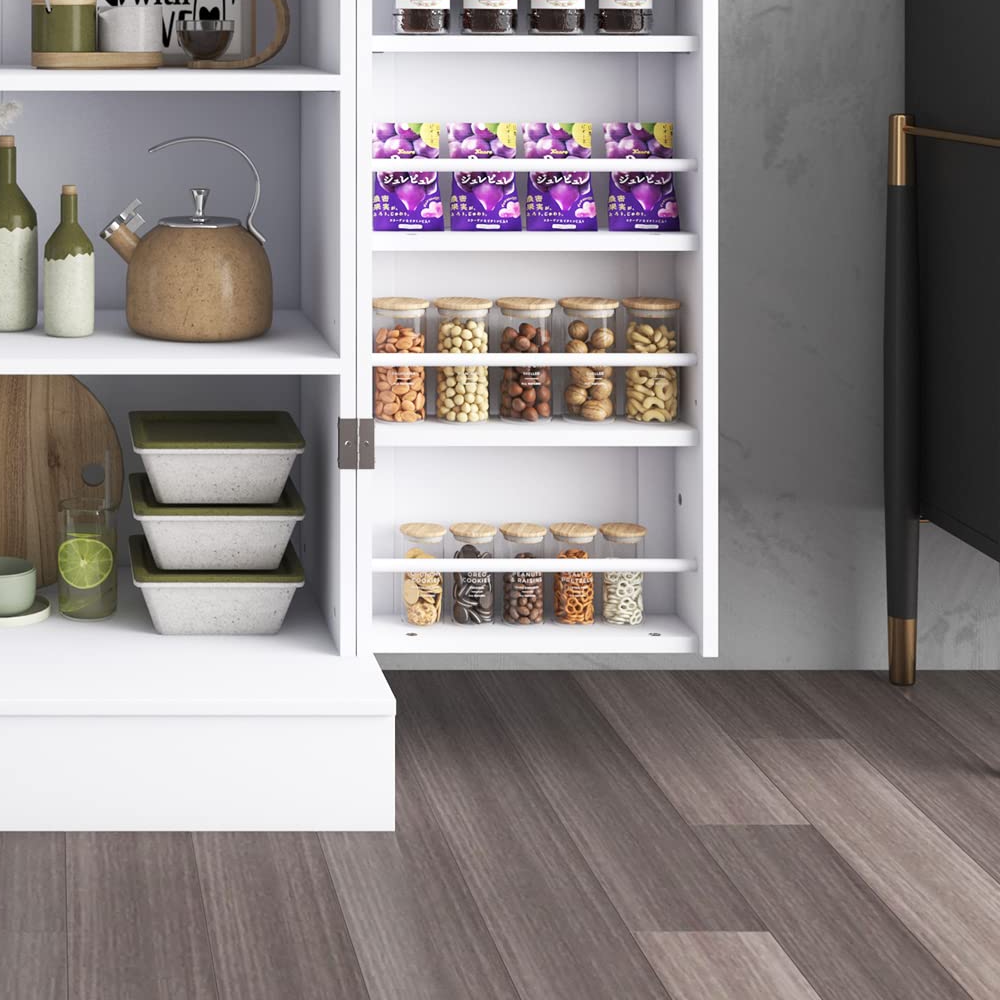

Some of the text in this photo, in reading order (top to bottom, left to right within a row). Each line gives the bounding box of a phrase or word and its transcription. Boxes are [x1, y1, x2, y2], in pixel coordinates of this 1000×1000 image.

[384, 174, 433, 185] ジュレピュレ
[461, 174, 510, 185] ジュレピュレ
[537, 174, 586, 185] ジュレピュレ
[620, 174, 668, 185] ジュレピュレ
